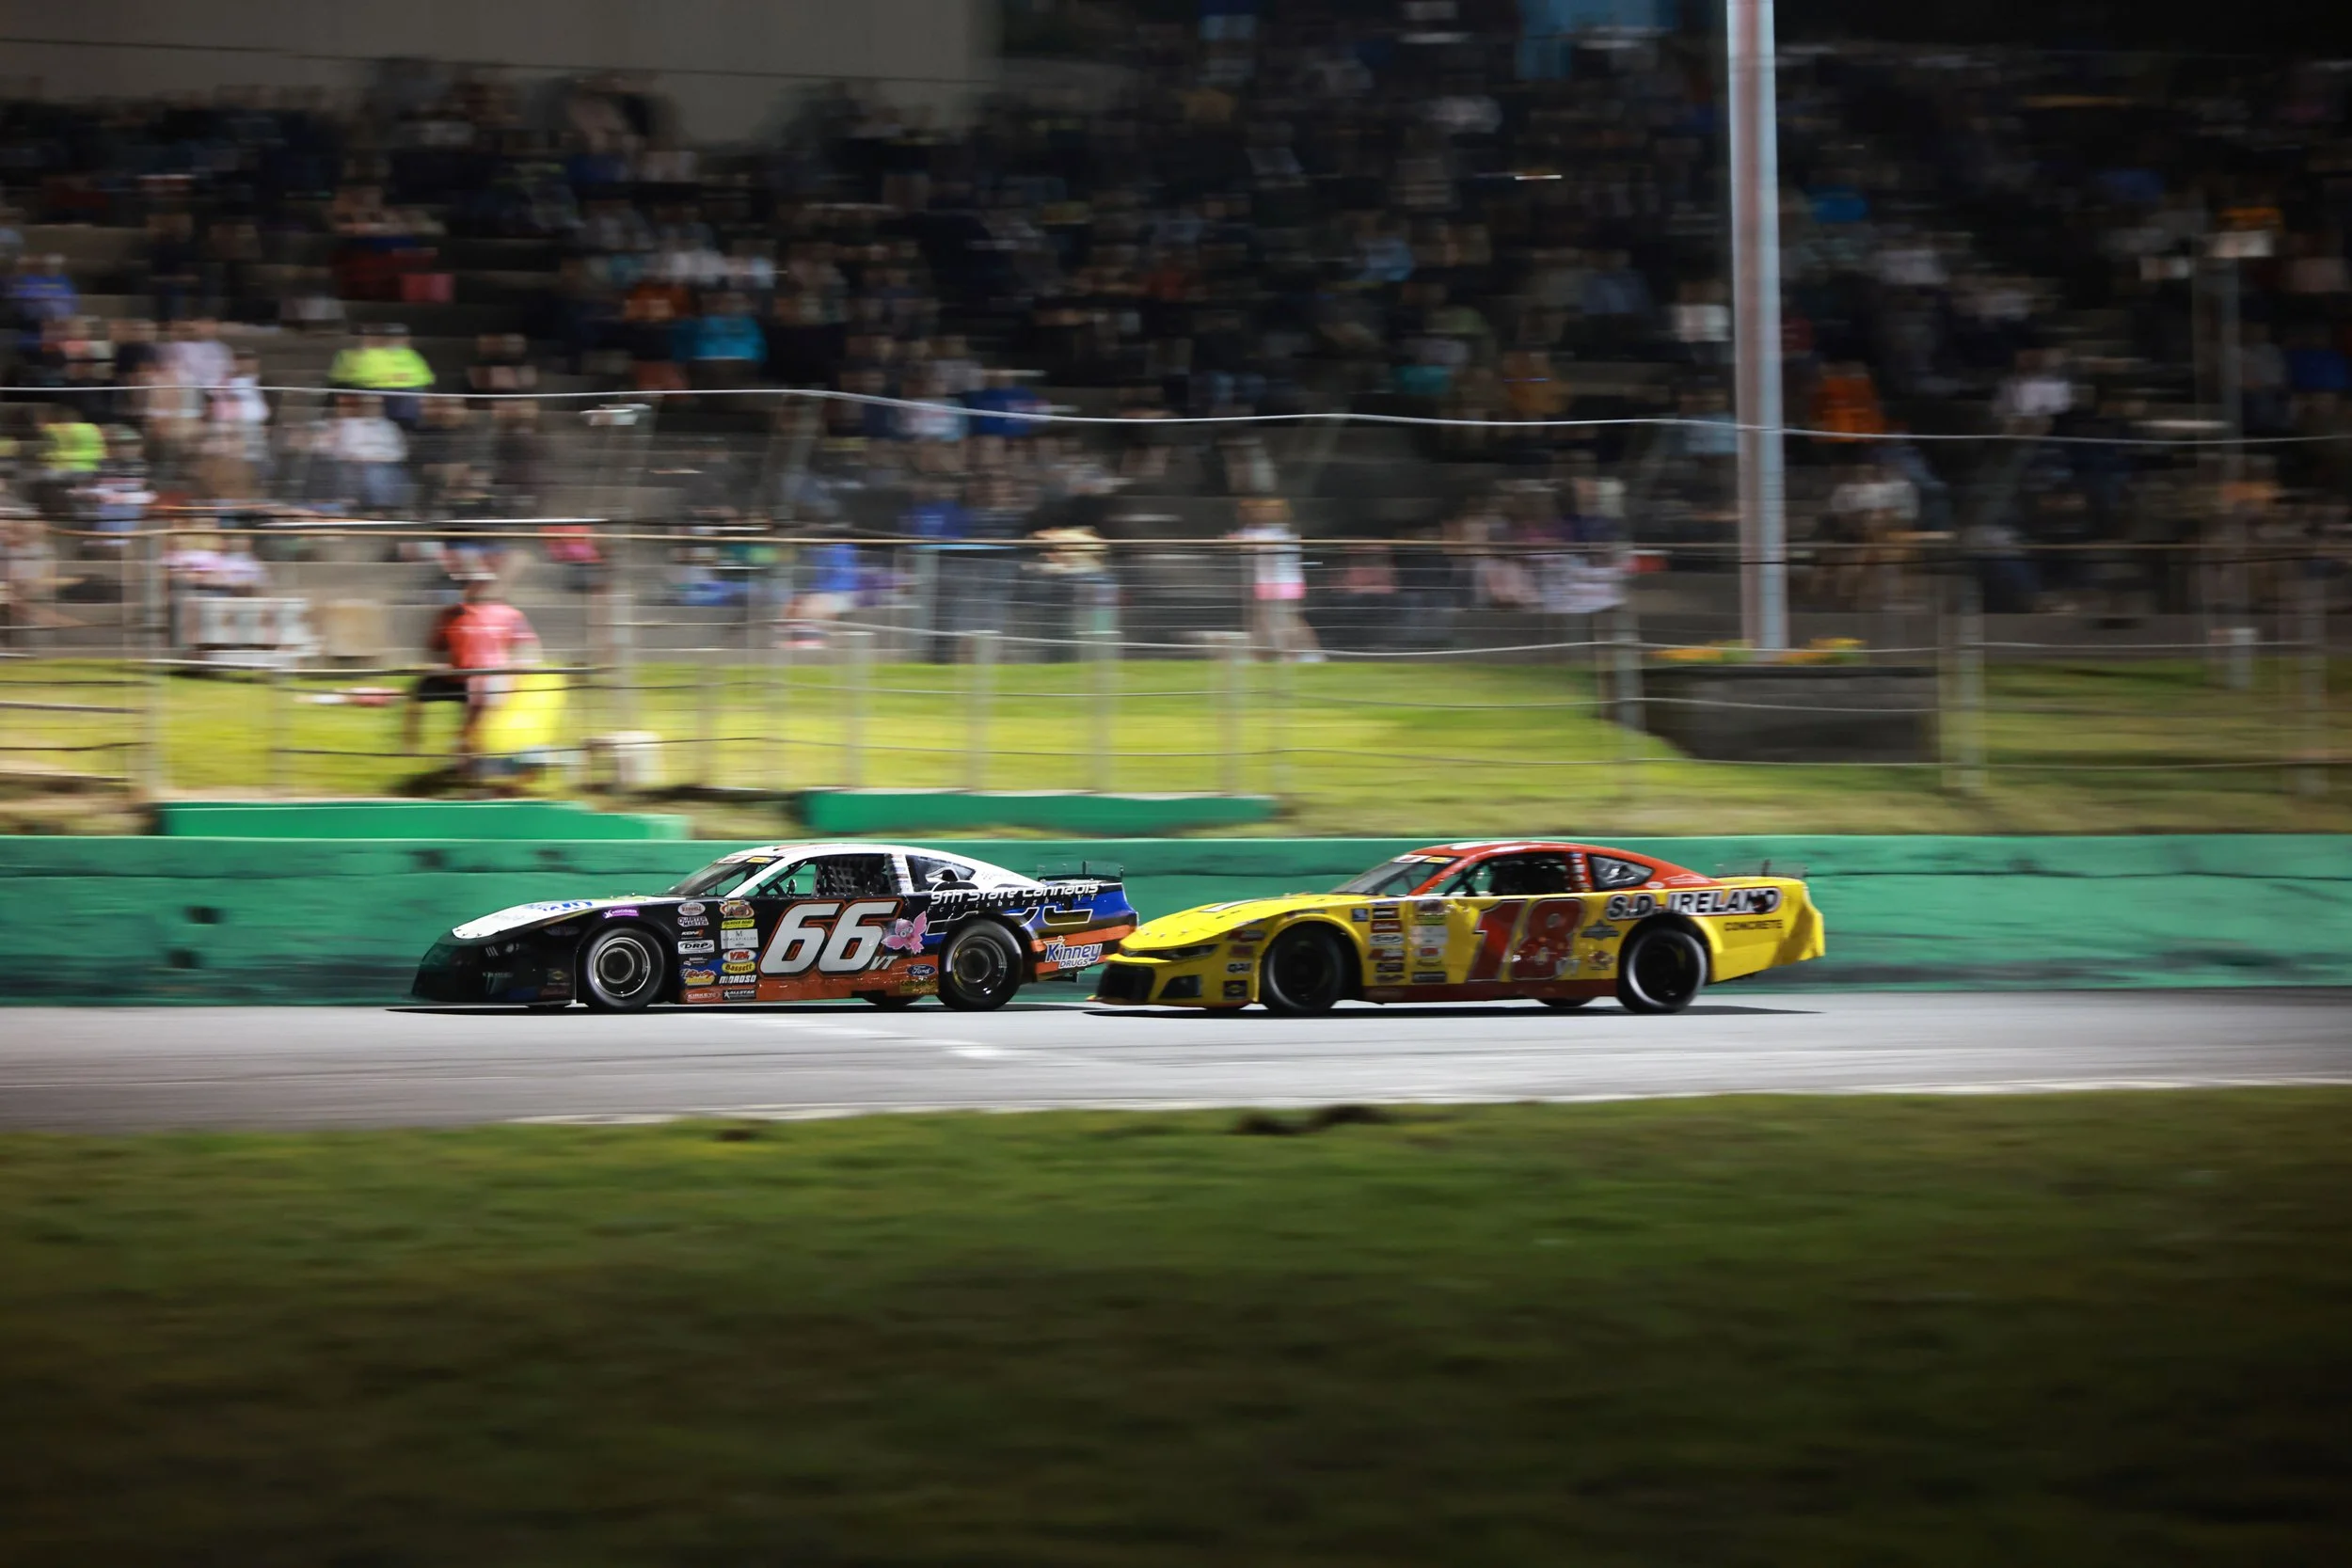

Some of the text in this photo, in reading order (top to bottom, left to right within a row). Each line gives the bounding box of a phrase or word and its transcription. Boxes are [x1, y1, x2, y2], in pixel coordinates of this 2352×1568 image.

[758, 900, 900, 975] 66
[1468, 898, 1584, 982] 18
[1046, 942, 1102, 962] Kinney
[725, 963, 754, 972] Bassett
[869, 955, 898, 970] VT
[1059, 959, 1089, 968] DRUGS
[911, 965, 931, 974] Ford
[719, 975, 756, 984] MOROSO
